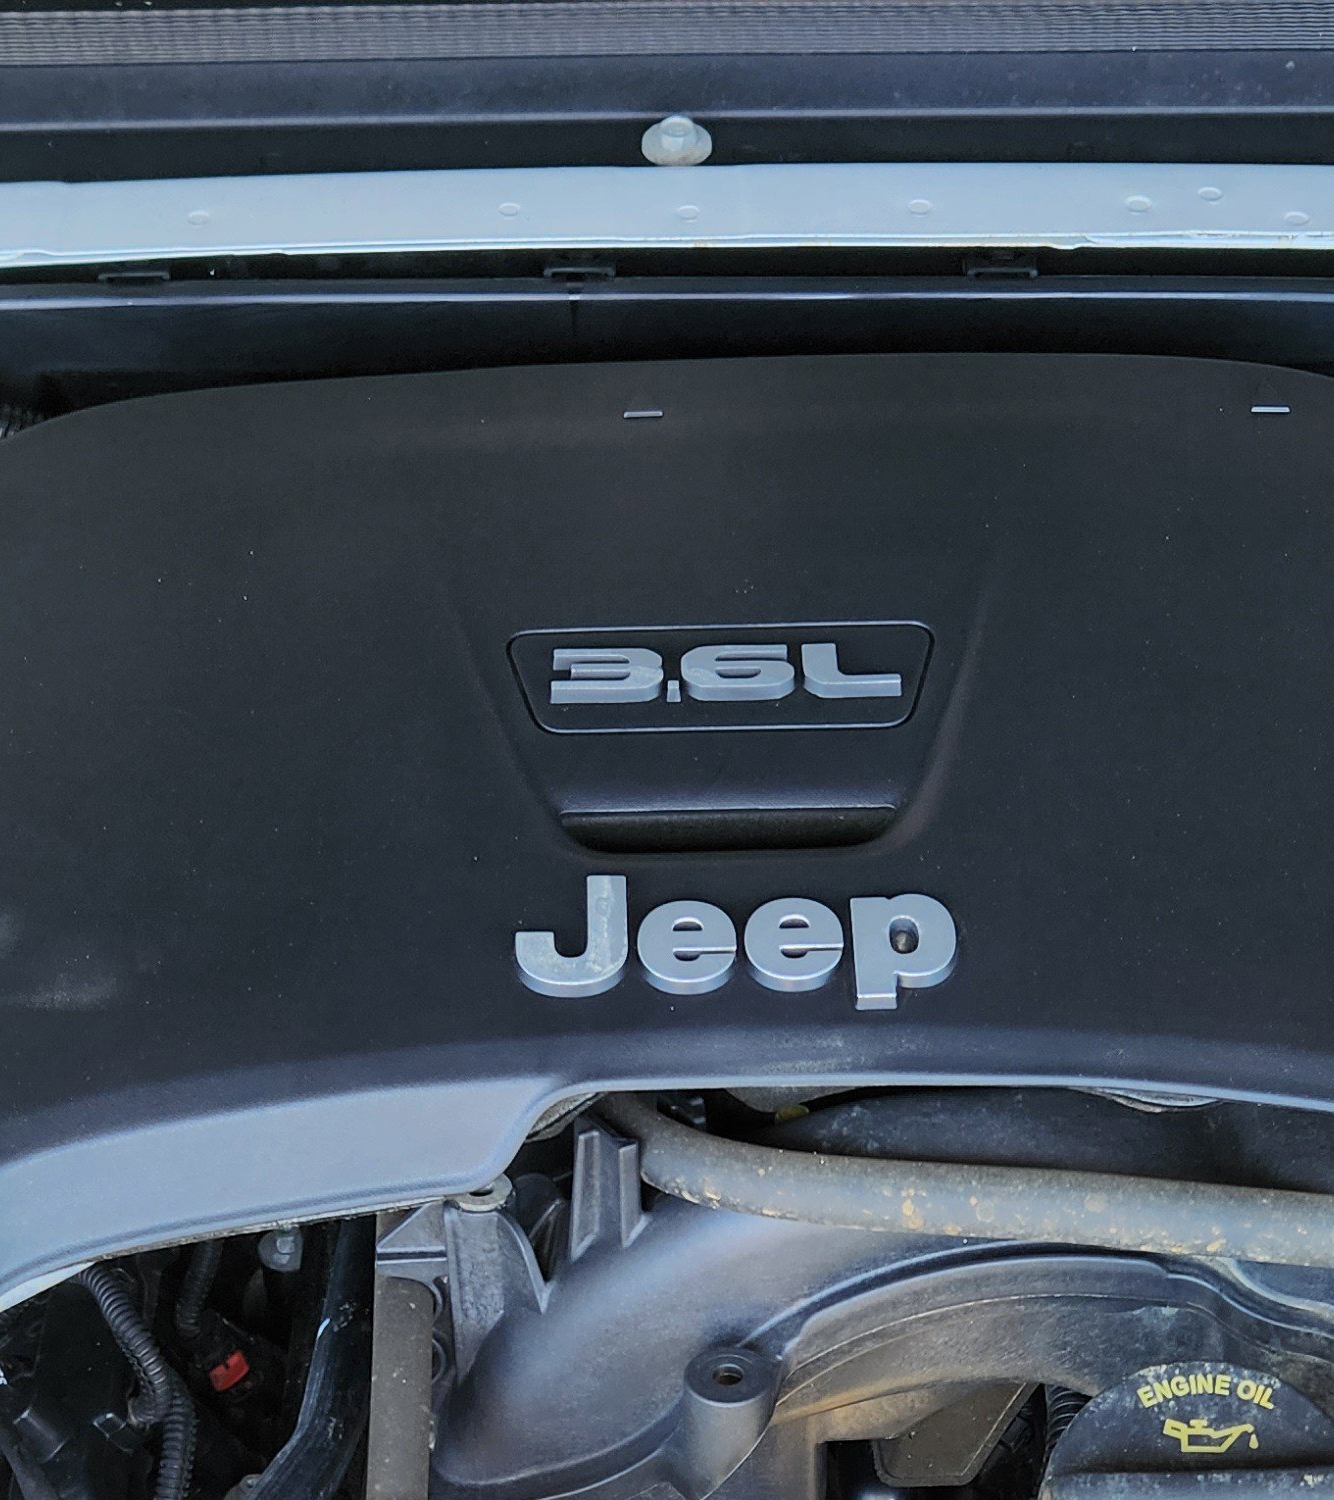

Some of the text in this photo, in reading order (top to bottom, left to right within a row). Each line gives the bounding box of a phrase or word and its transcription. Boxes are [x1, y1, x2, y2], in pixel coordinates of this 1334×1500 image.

[550, 643, 902, 704] 3.6L
[515, 875, 957, 1010] Jeep
[1136, 1373, 1274, 1410] ENGINE OIL
